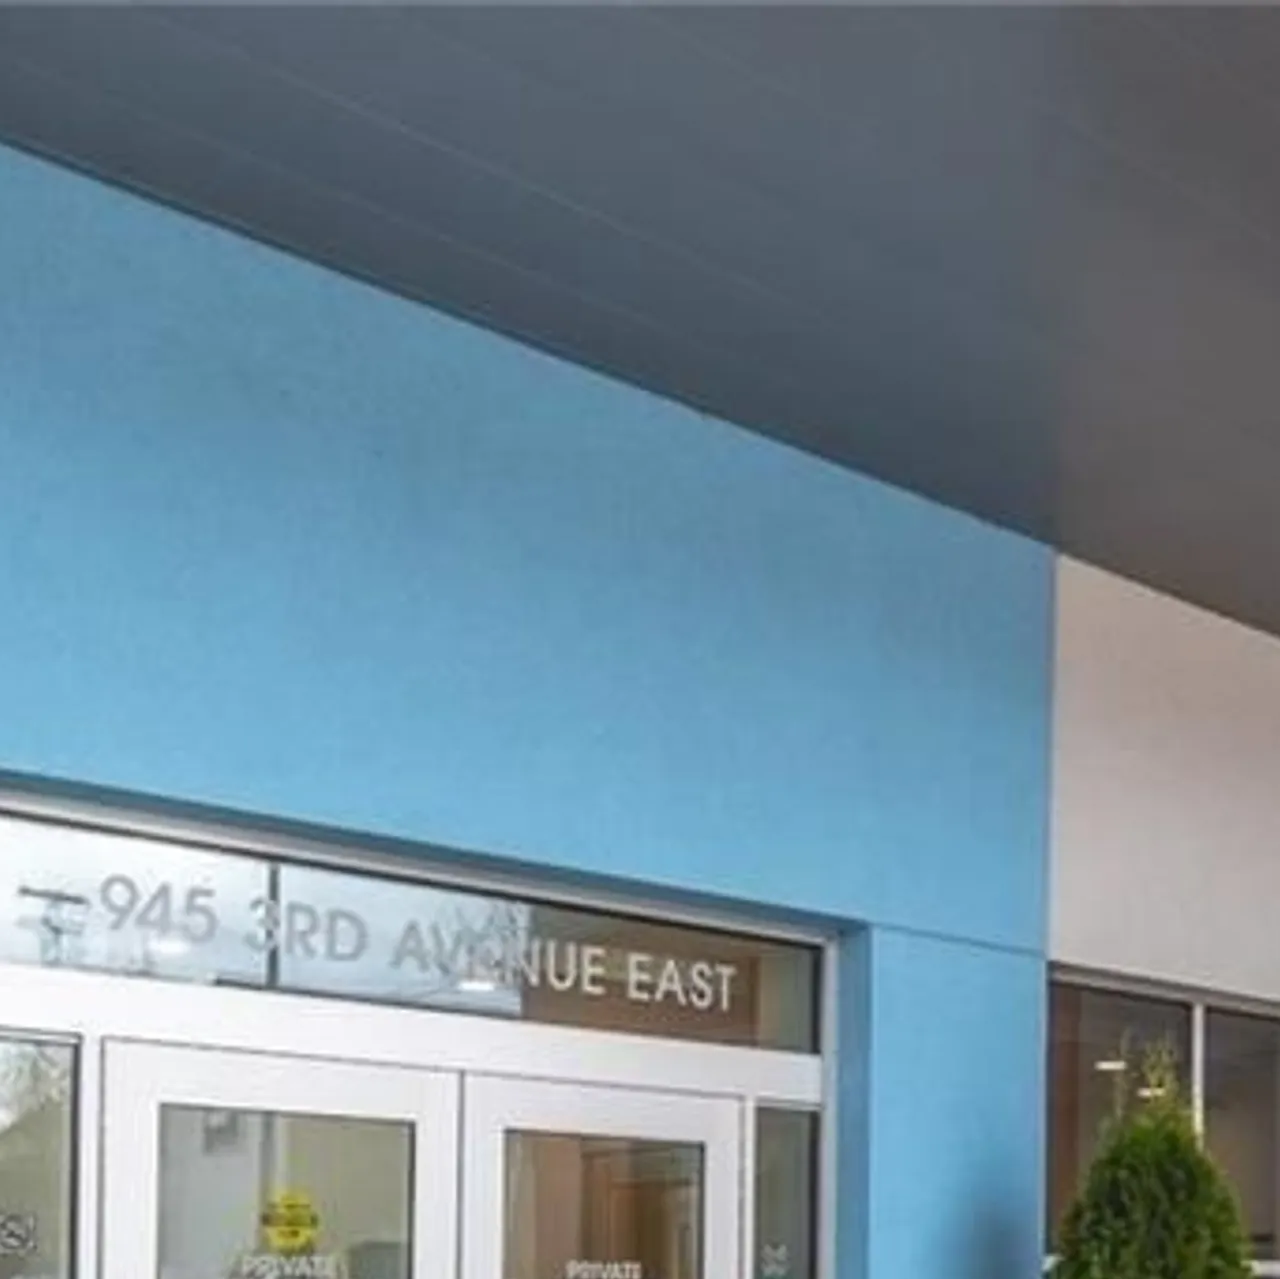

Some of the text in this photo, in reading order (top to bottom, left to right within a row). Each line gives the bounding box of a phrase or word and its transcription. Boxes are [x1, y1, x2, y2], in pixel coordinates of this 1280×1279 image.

[99, 873, 218, 945] 945
[243, 897, 369, 962] 3RD
[626, 952, 737, 1012] EAST
